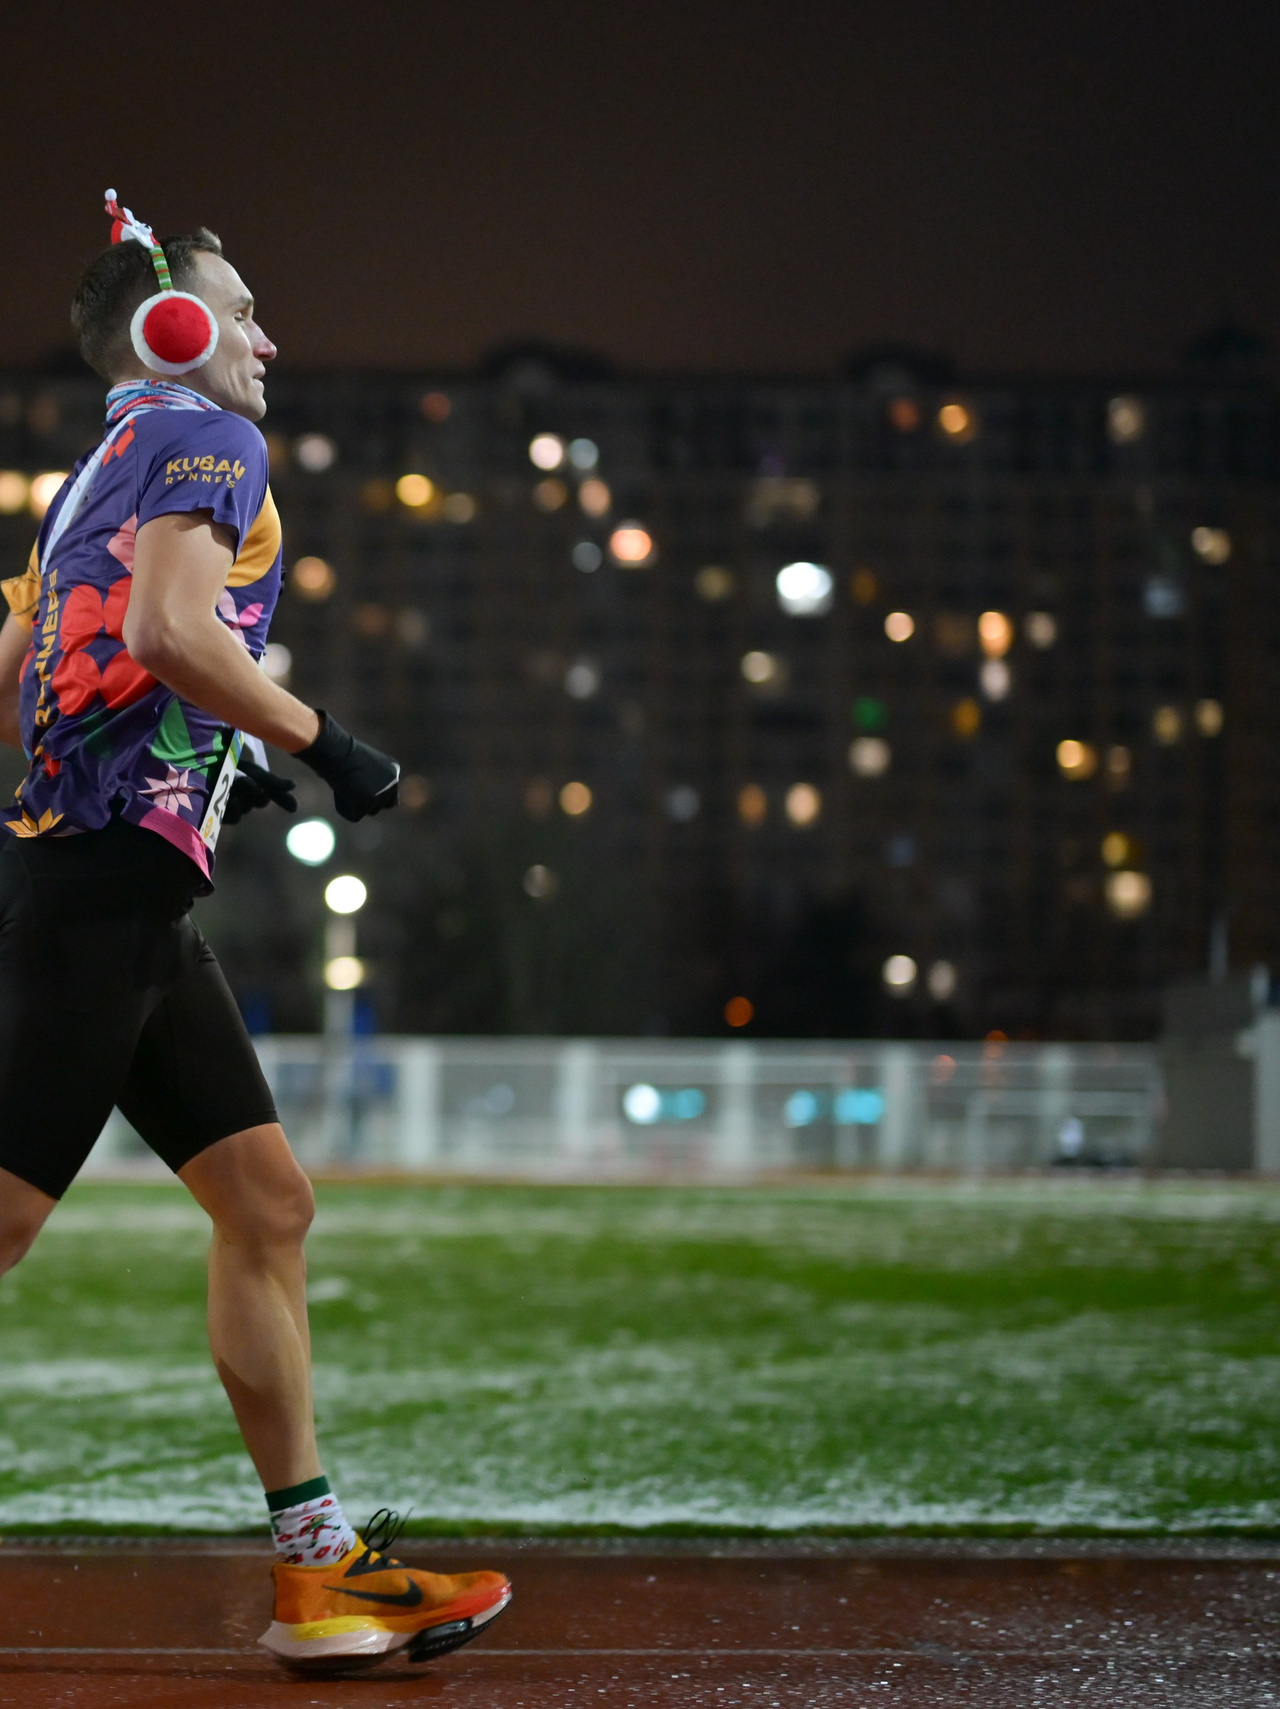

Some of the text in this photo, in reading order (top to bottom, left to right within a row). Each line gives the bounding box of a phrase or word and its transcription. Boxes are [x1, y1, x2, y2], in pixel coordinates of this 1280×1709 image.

[165, 472, 236, 488] RUNNERS
[166, 455, 246, 480] KUBAN
[213, 773, 230, 820] 2
